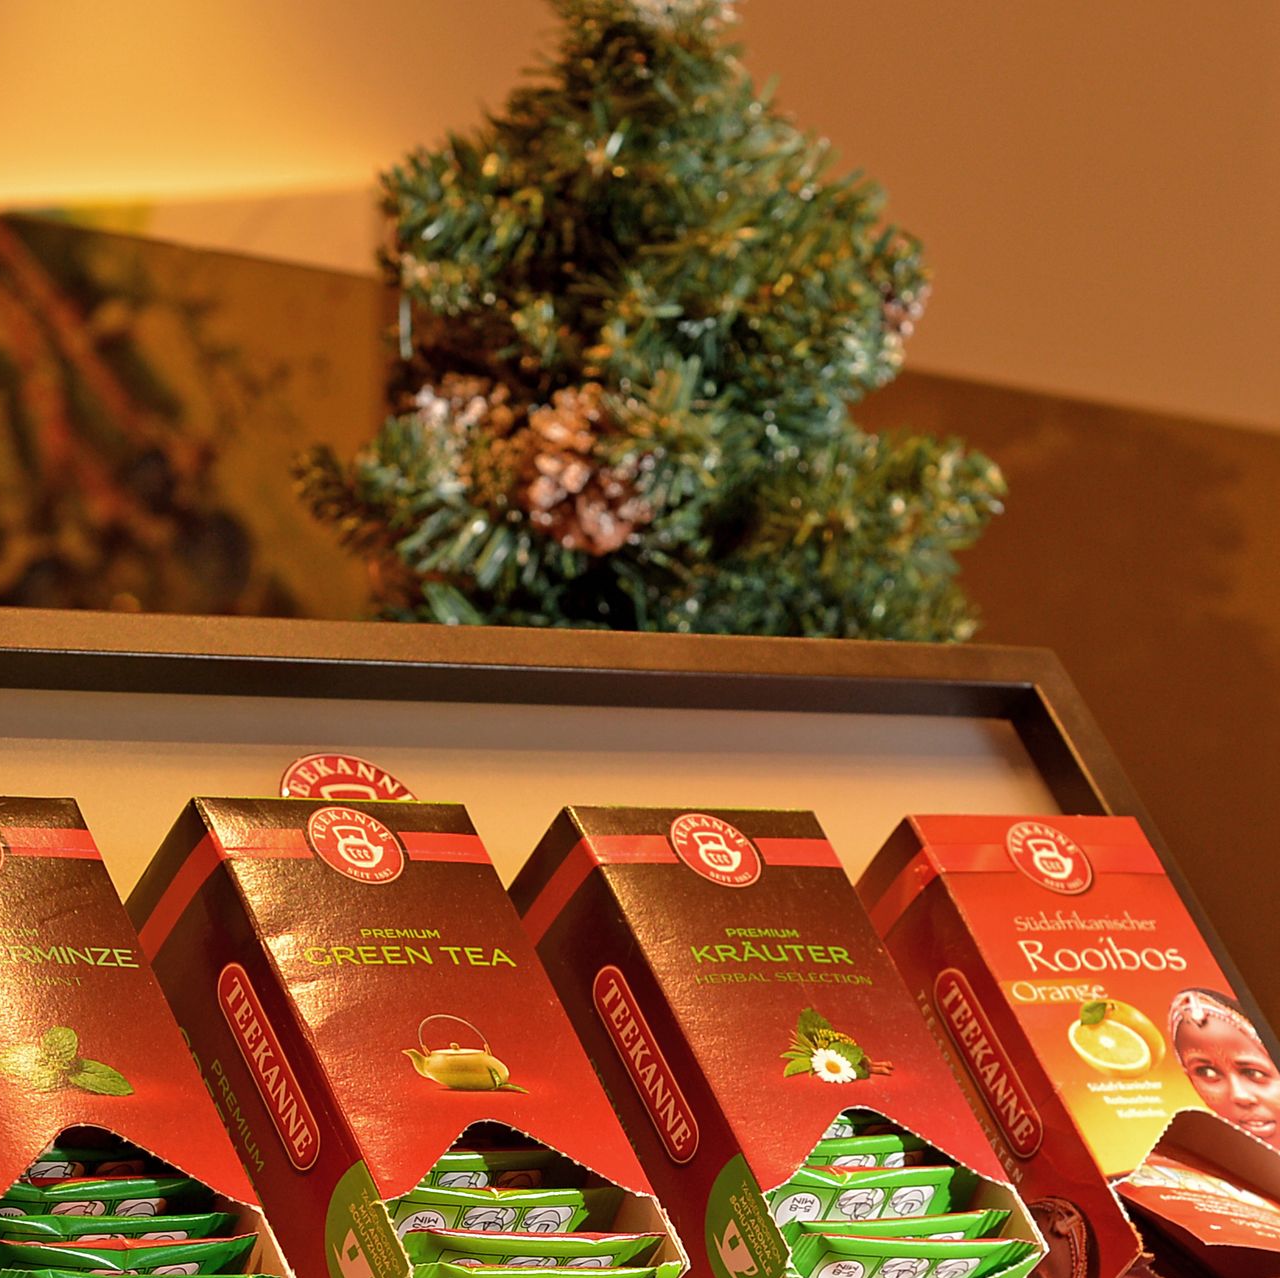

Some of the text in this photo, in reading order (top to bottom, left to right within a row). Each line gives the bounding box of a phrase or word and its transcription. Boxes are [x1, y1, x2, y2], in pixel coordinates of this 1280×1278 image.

[288, 758, 415, 800] EEKANN
[313, 809, 389, 842] TEEKANNE
[676, 814, 745, 846] TEEKANNE
[360, 929, 440, 939] PREMIUM
[725, 927, 800, 939] PREMIUM
[1013, 911, 1157, 932] Südafrikanischer
[304, 946, 517, 968] GREEN TEA
[690, 940, 854, 965] KRÄUTER
[1018, 937, 1187, 972] Rooibos
[695, 971, 873, 986] HERBAL SELECTION
[1011, 981, 1108, 1003] Orange
[225, 977, 312, 1157] TEEKANNE
[602, 978, 684, 1152] TEEKANNE
[940, 981, 1034, 1145] TEEKANNE
[211, 1059, 264, 1172] PREMIUM
[792, 1197, 815, 1205] MIN
[836, 1263, 859, 1271] MIN
